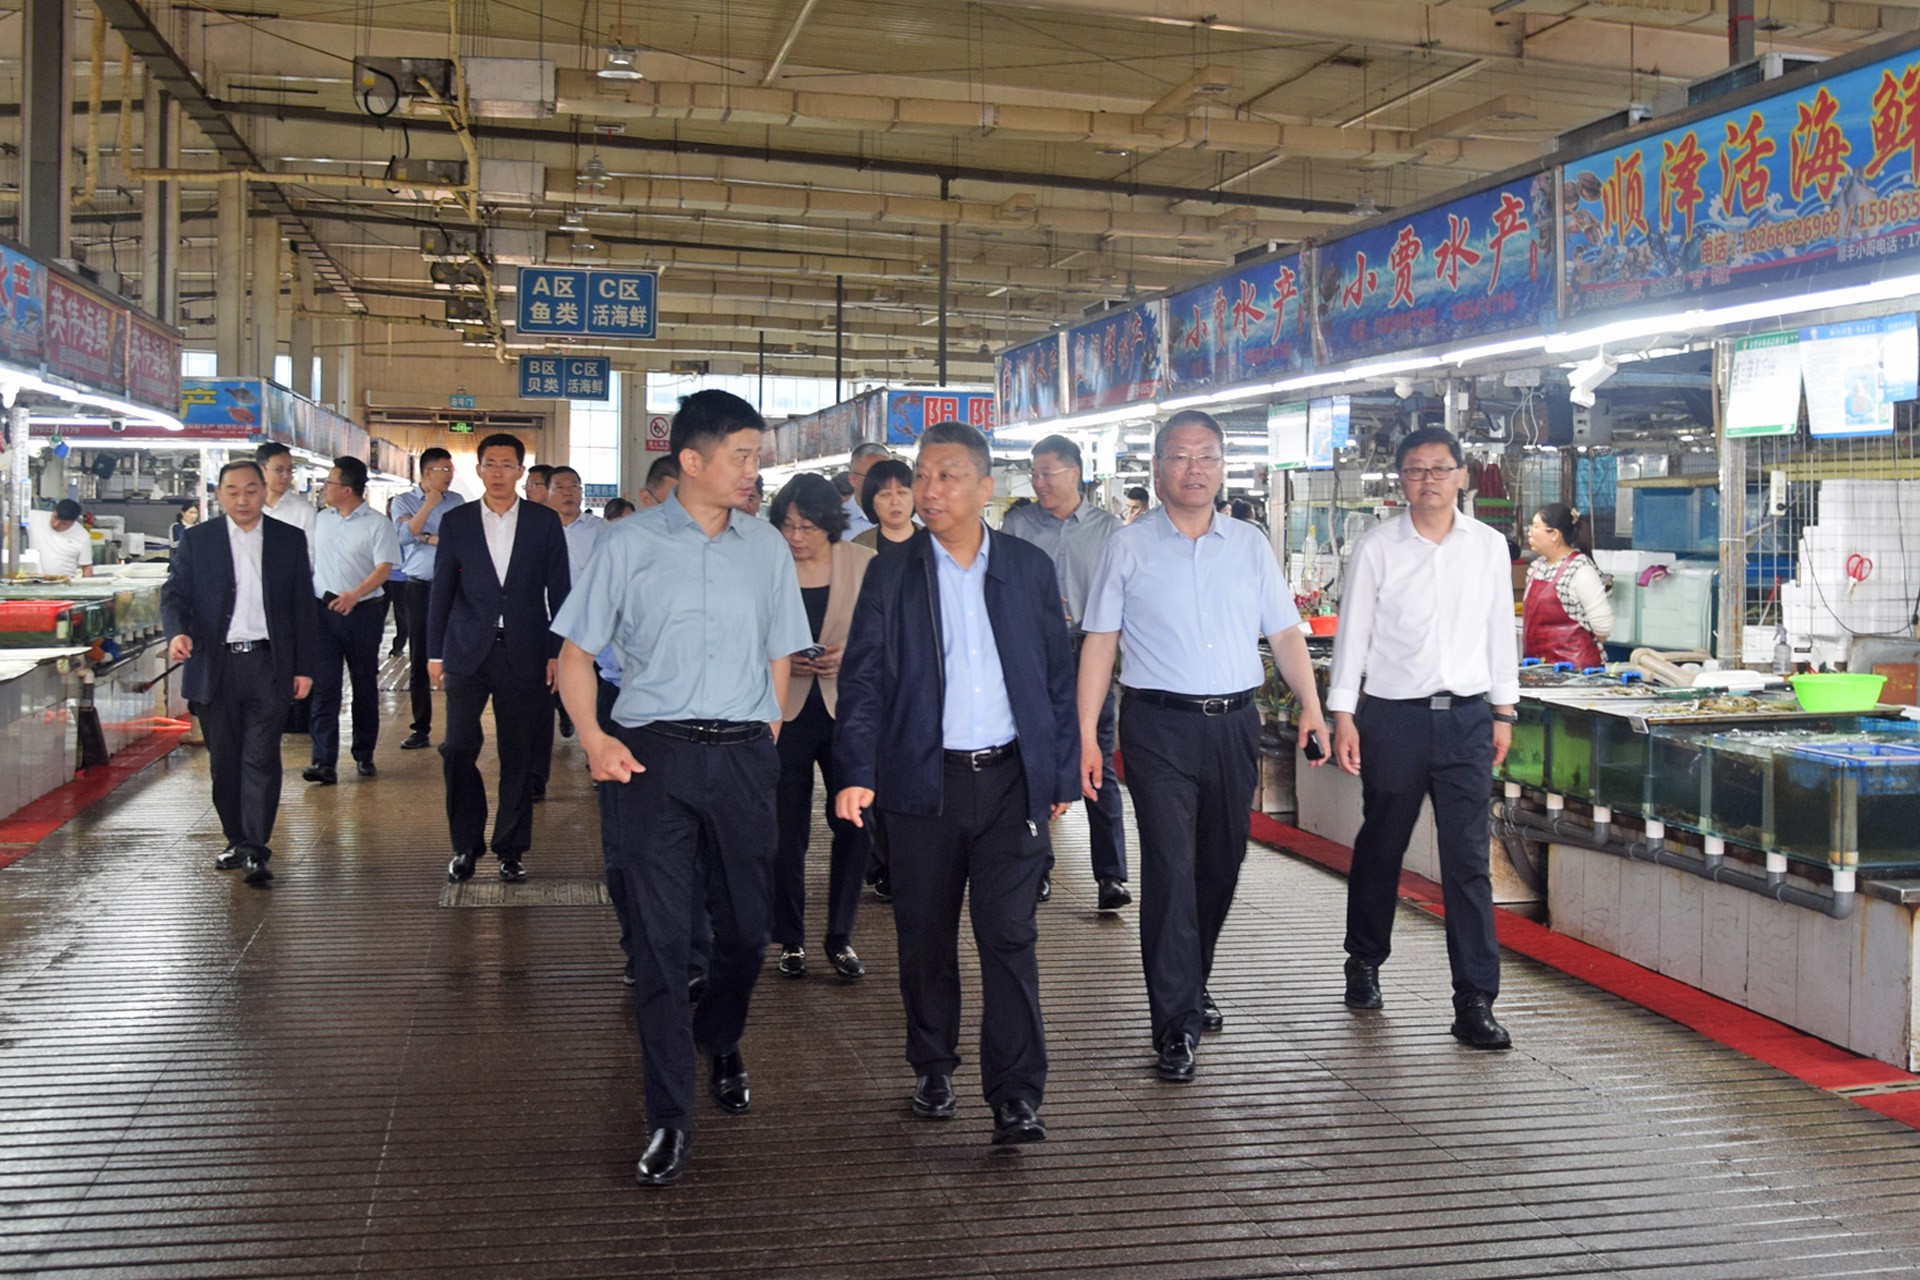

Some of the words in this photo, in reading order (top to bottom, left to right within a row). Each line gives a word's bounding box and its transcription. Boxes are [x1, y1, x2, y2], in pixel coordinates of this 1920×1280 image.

[1601, 62, 1920, 244] 顺泽活海鲜
[1342, 193, 1529, 309] 小贾水产
[532, 276, 575, 298] A区
[599, 279, 640, 301] C区
[529, 301, 578, 325] 鱼类
[592, 304, 647, 328] 活海鲜
[1185, 266, 1298, 353] 小贾水产
[529, 361, 556, 375] B区
[571, 363, 598, 377] C区
[527, 377, 559, 393] 贝类
[568, 379, 603, 394] 活海鲜
